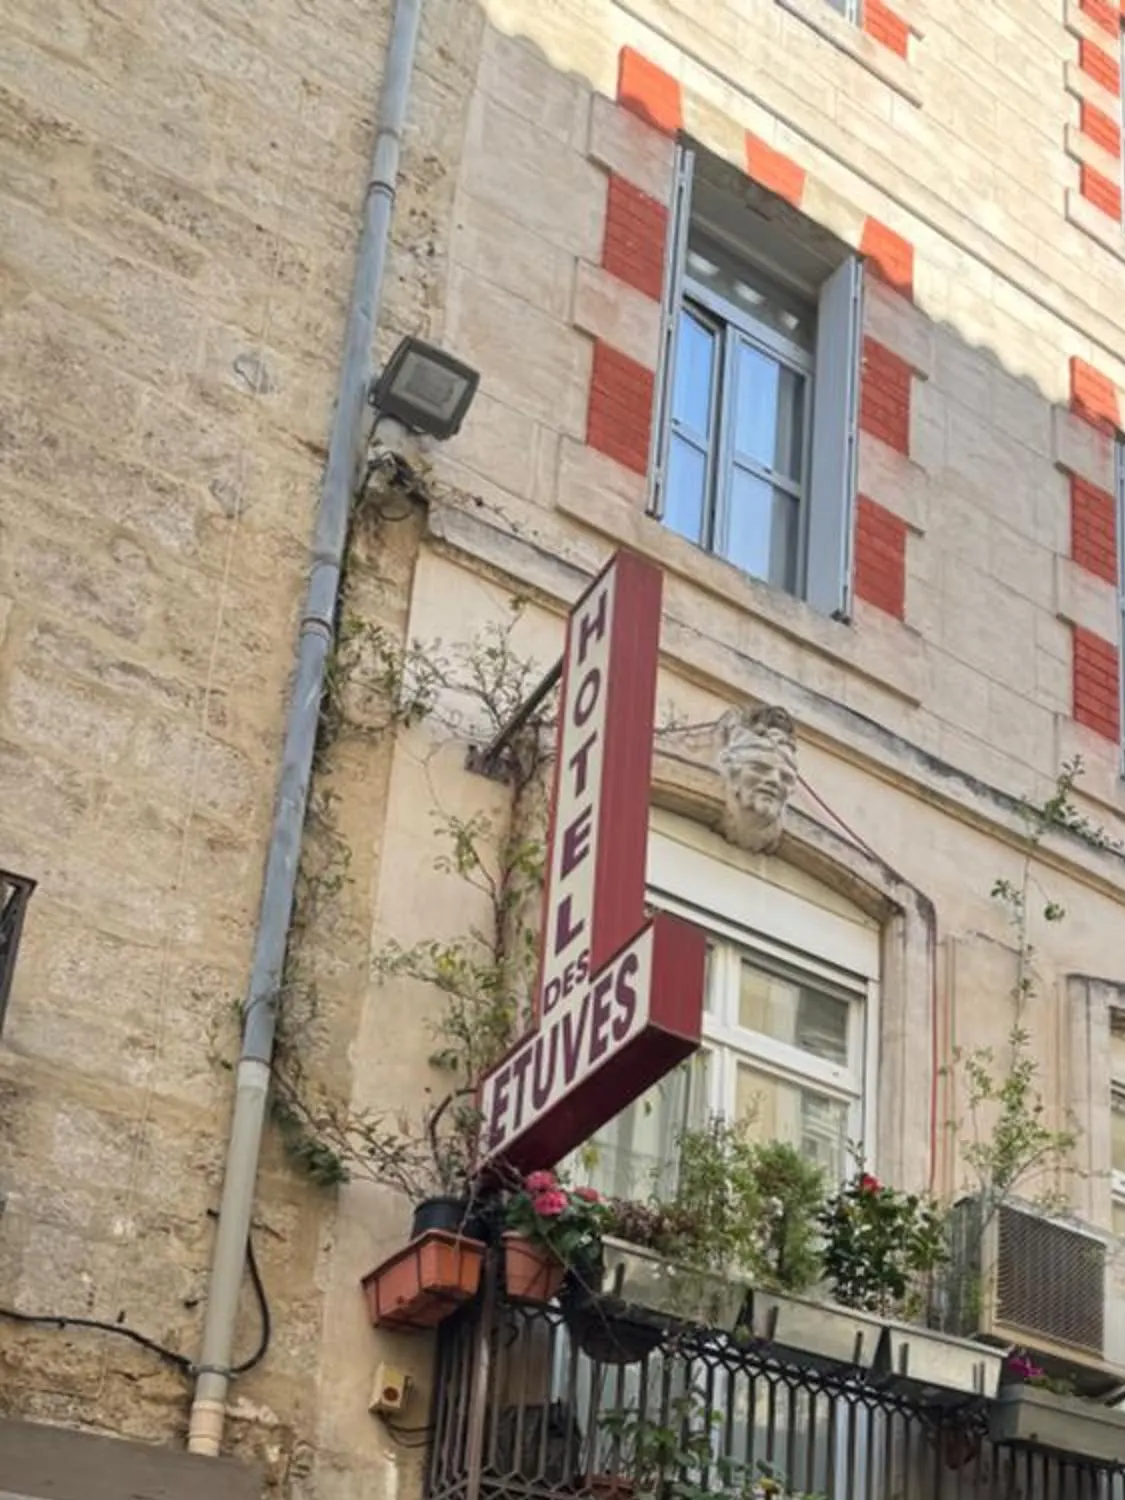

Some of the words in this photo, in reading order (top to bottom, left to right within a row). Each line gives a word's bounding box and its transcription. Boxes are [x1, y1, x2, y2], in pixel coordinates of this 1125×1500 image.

[551, 588, 607, 958] HOTEL
[488, 952, 640, 1150] ETUVES
[543, 948, 591, 1016] DES
